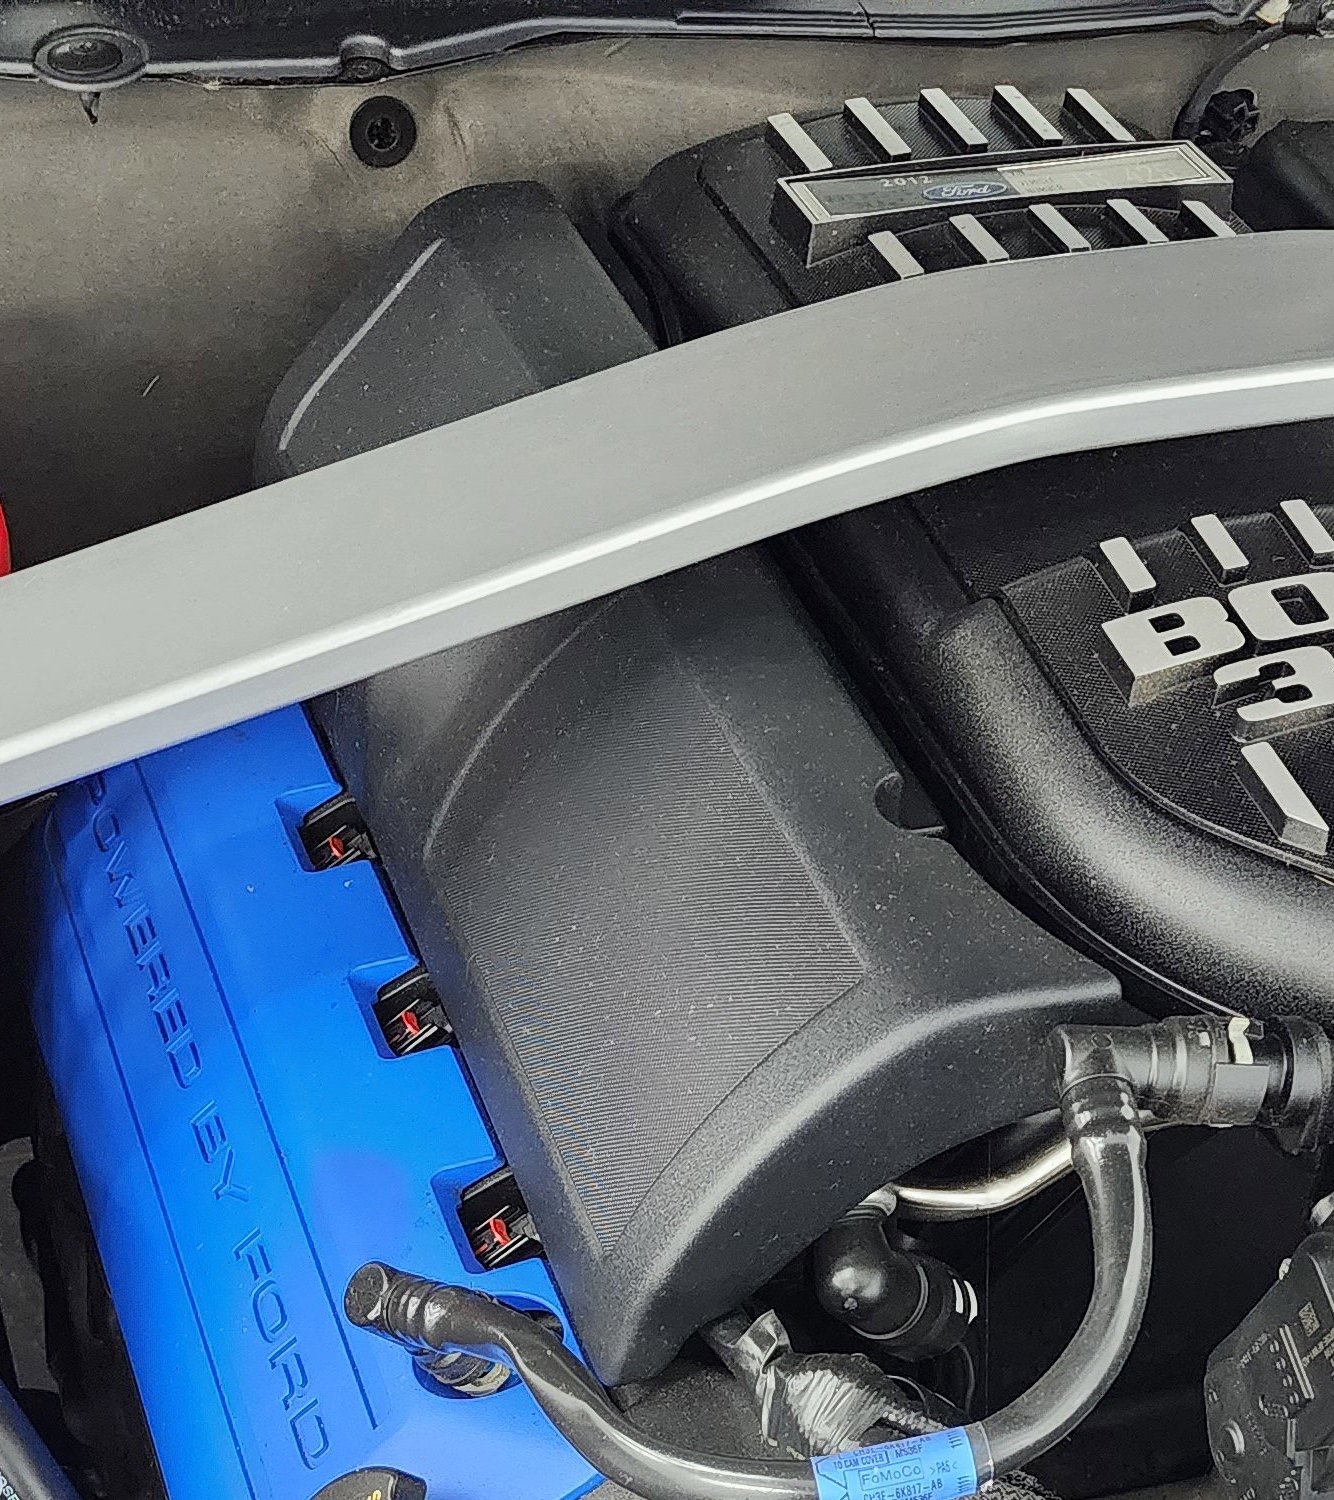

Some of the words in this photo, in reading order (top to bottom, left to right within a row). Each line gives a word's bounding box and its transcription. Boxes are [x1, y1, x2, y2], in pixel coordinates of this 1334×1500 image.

[880, 175, 934, 188] 2012
[189, 1099, 250, 1201] BY
[232, 1226, 330, 1471] FORD
[861, 1464, 922, 1486] FoMoCo
